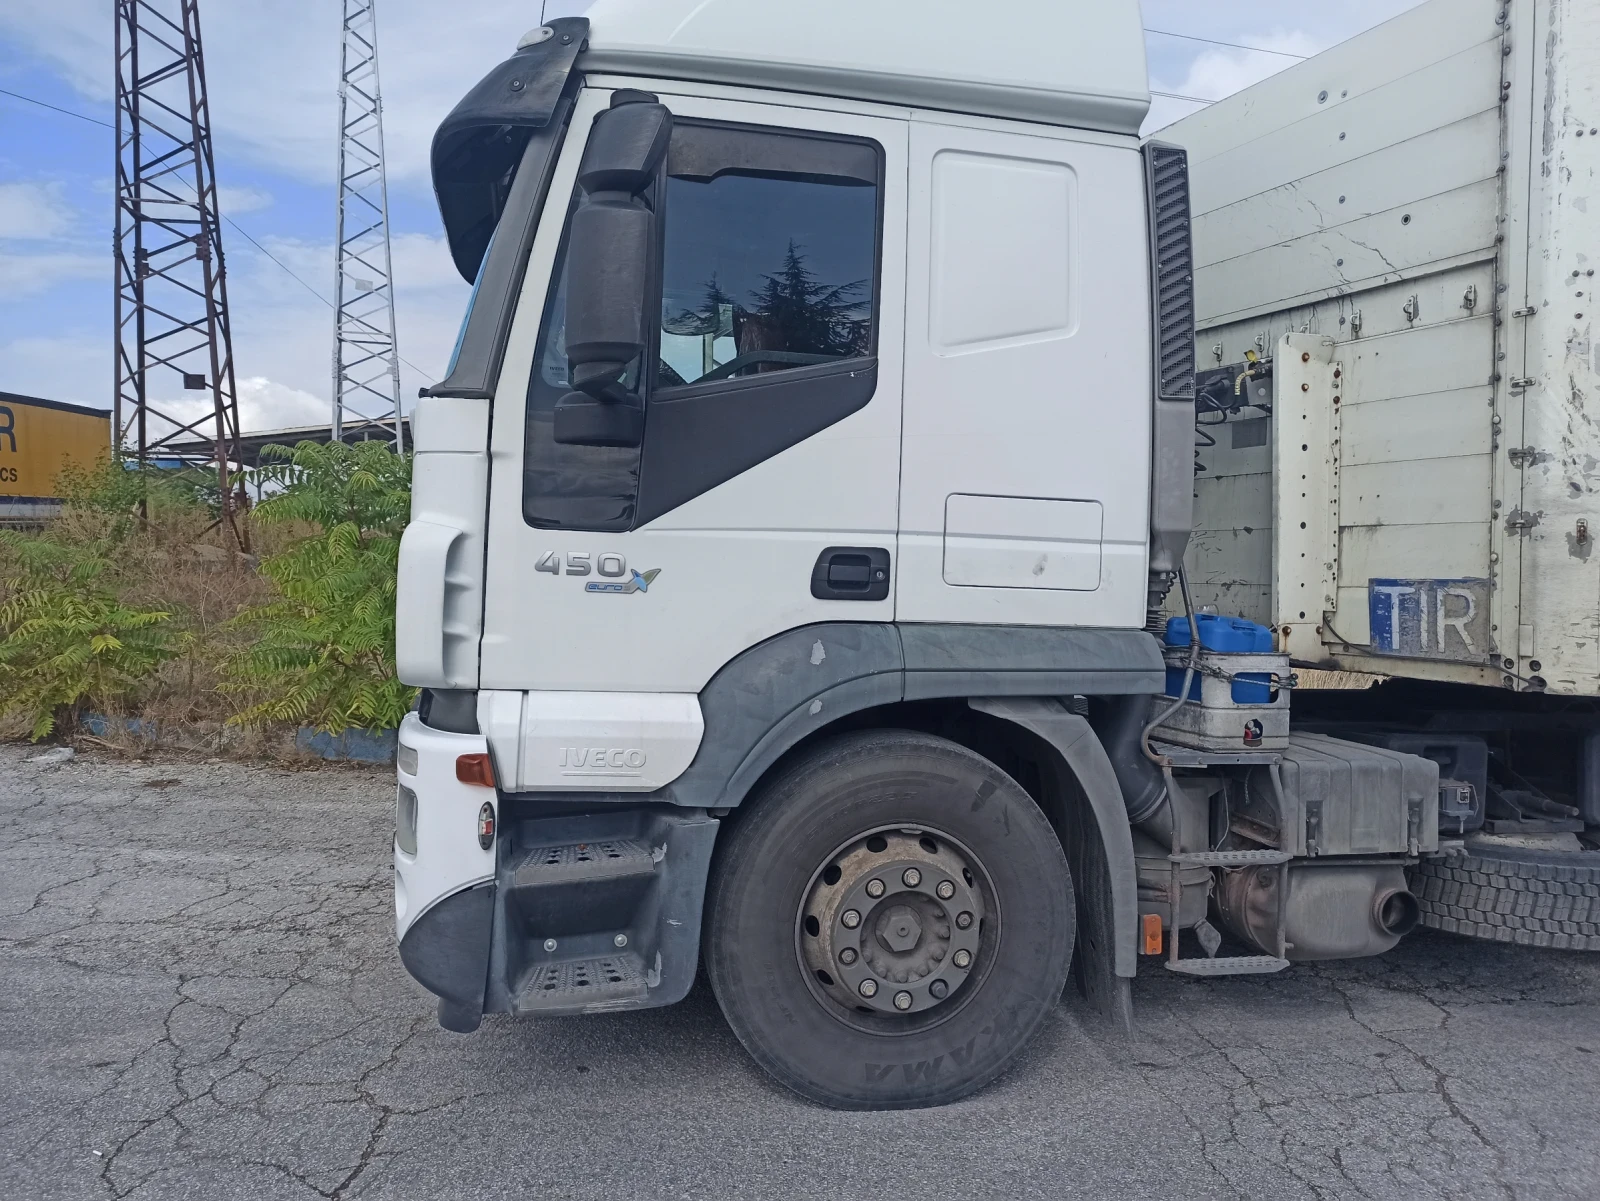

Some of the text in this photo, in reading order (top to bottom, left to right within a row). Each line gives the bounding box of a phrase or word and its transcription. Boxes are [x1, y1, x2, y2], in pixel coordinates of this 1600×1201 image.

[0, 405, 17, 453] R
[0, 467, 18, 482] CS
[534, 550, 627, 578] 450
[588, 583, 623, 591] euro
[1373, 586, 1482, 656] TIR
[559, 747, 647, 768] IVECO
